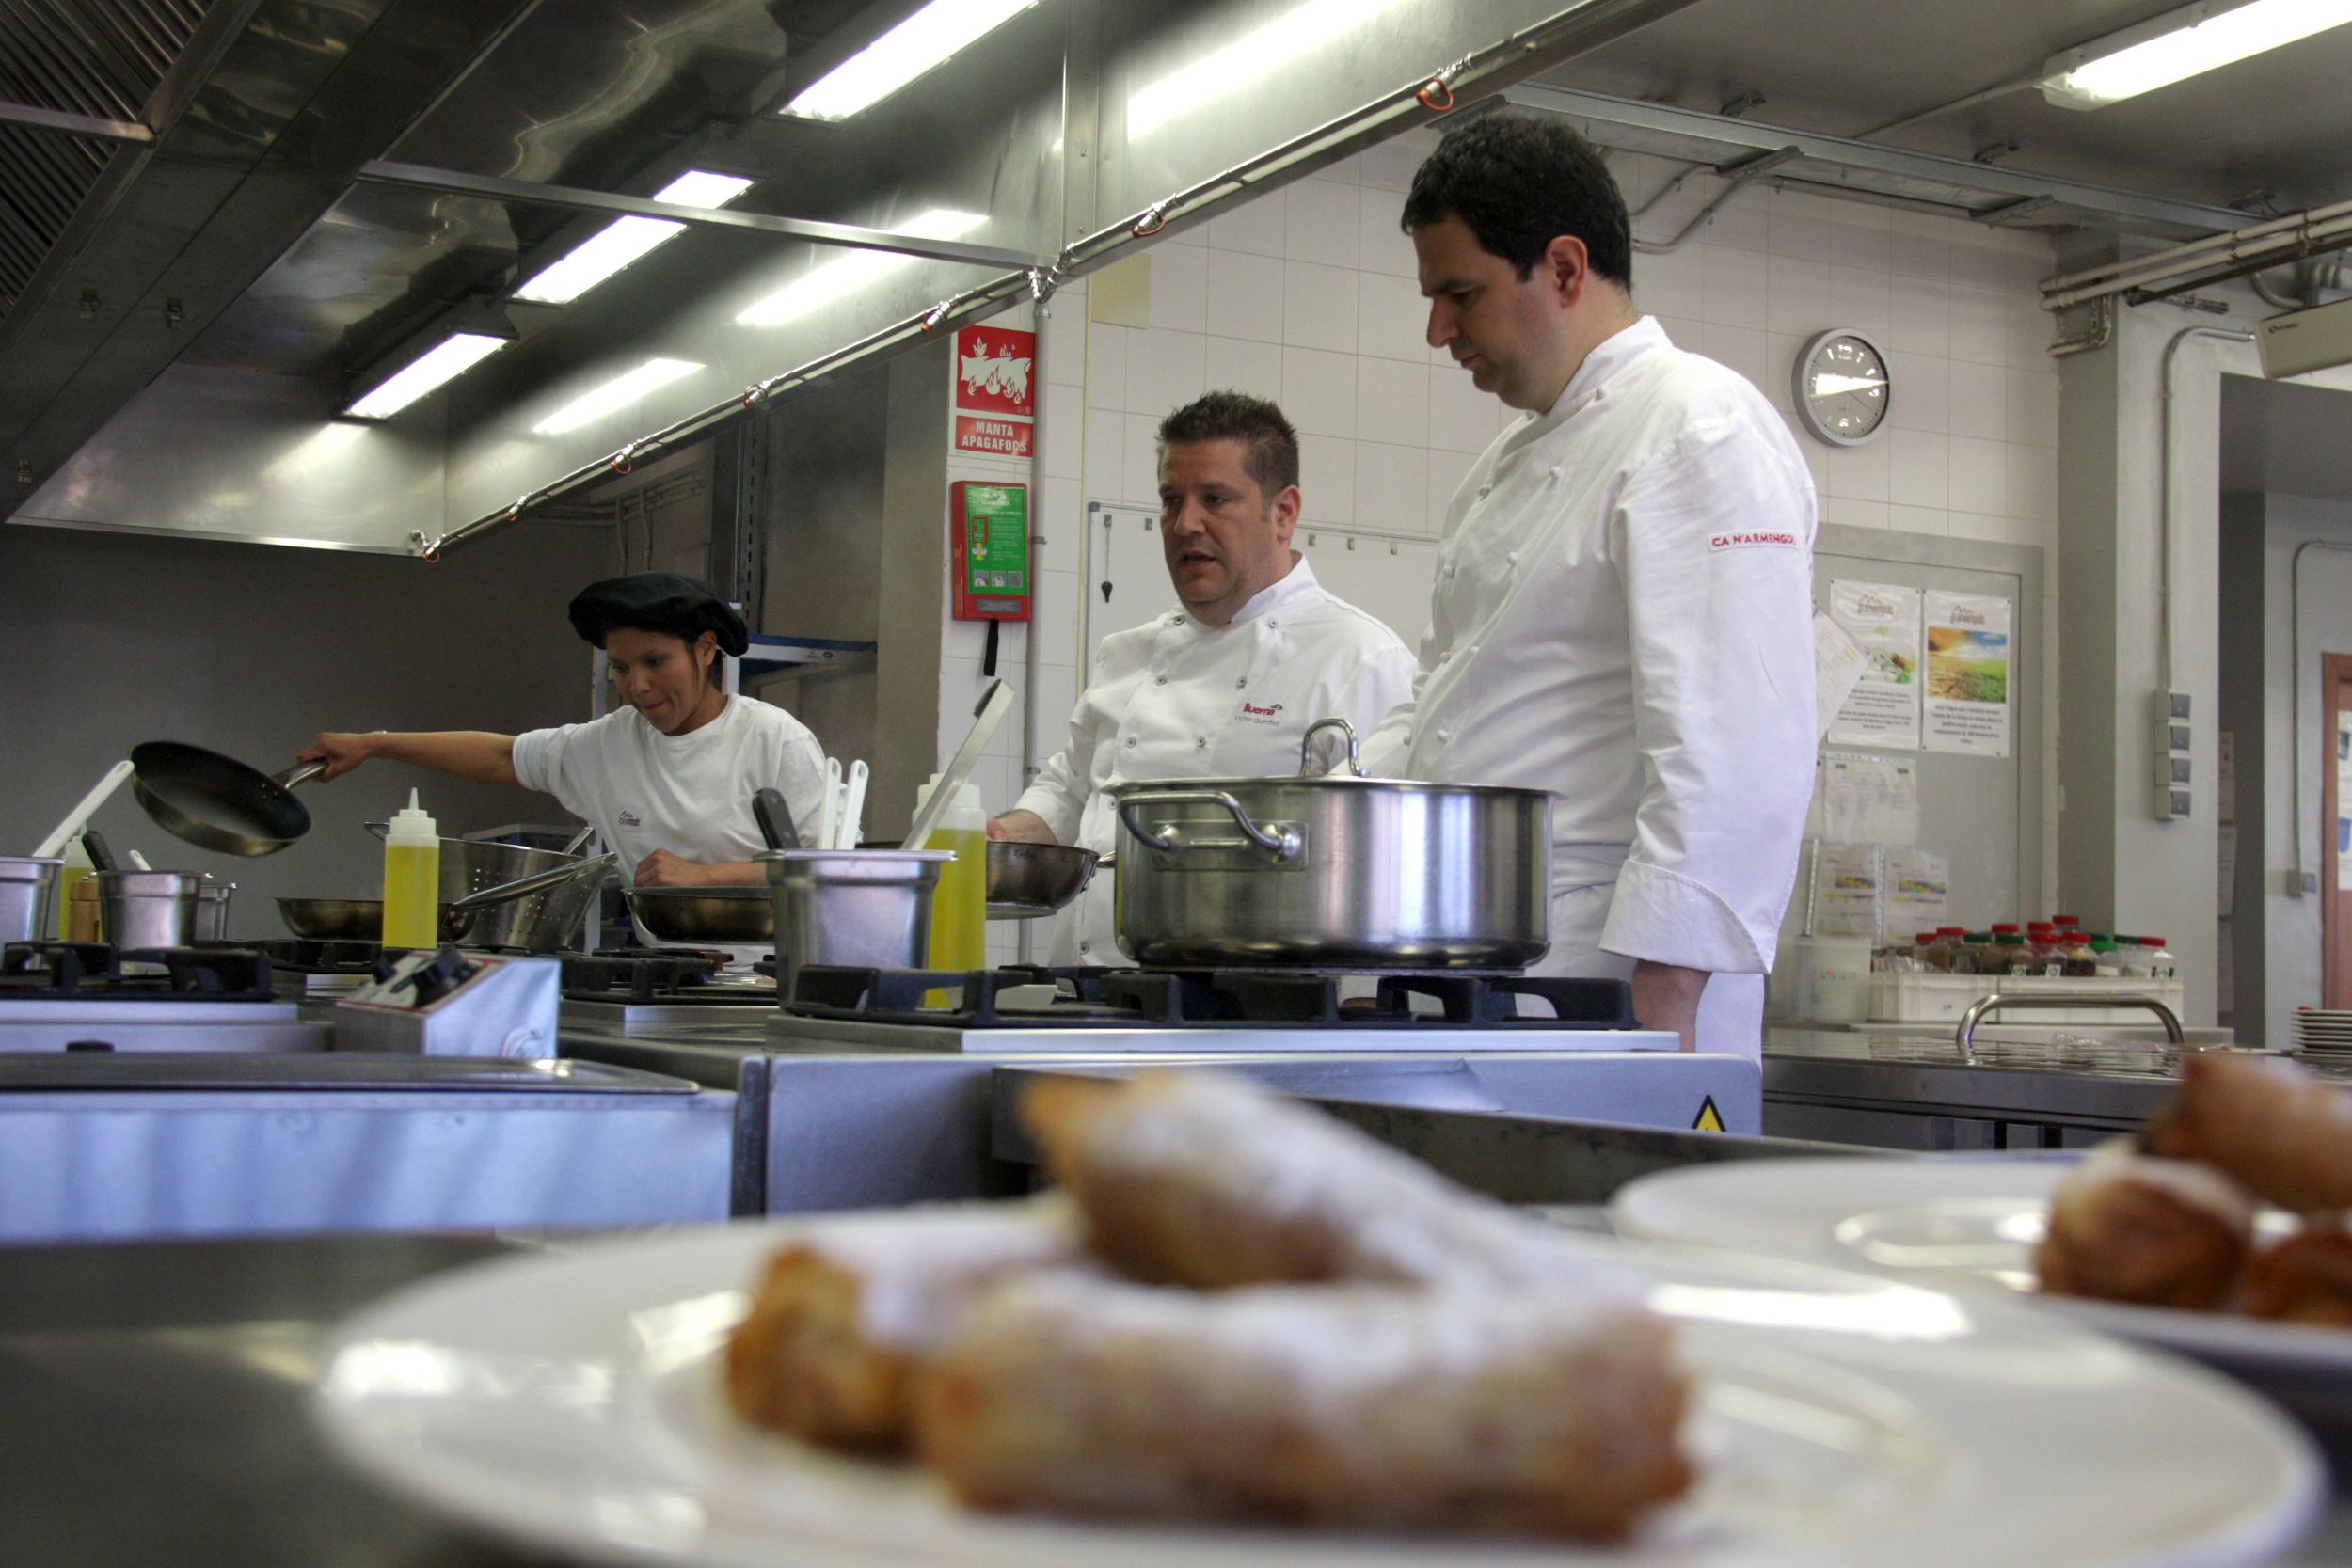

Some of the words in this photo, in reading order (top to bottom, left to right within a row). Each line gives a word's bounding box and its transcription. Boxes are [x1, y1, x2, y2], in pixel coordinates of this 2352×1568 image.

[976, 420, 1014, 437] MANTA
[961, 435, 1027, 452] APAGAFOCS
[1711, 537, 1730, 547] CA
